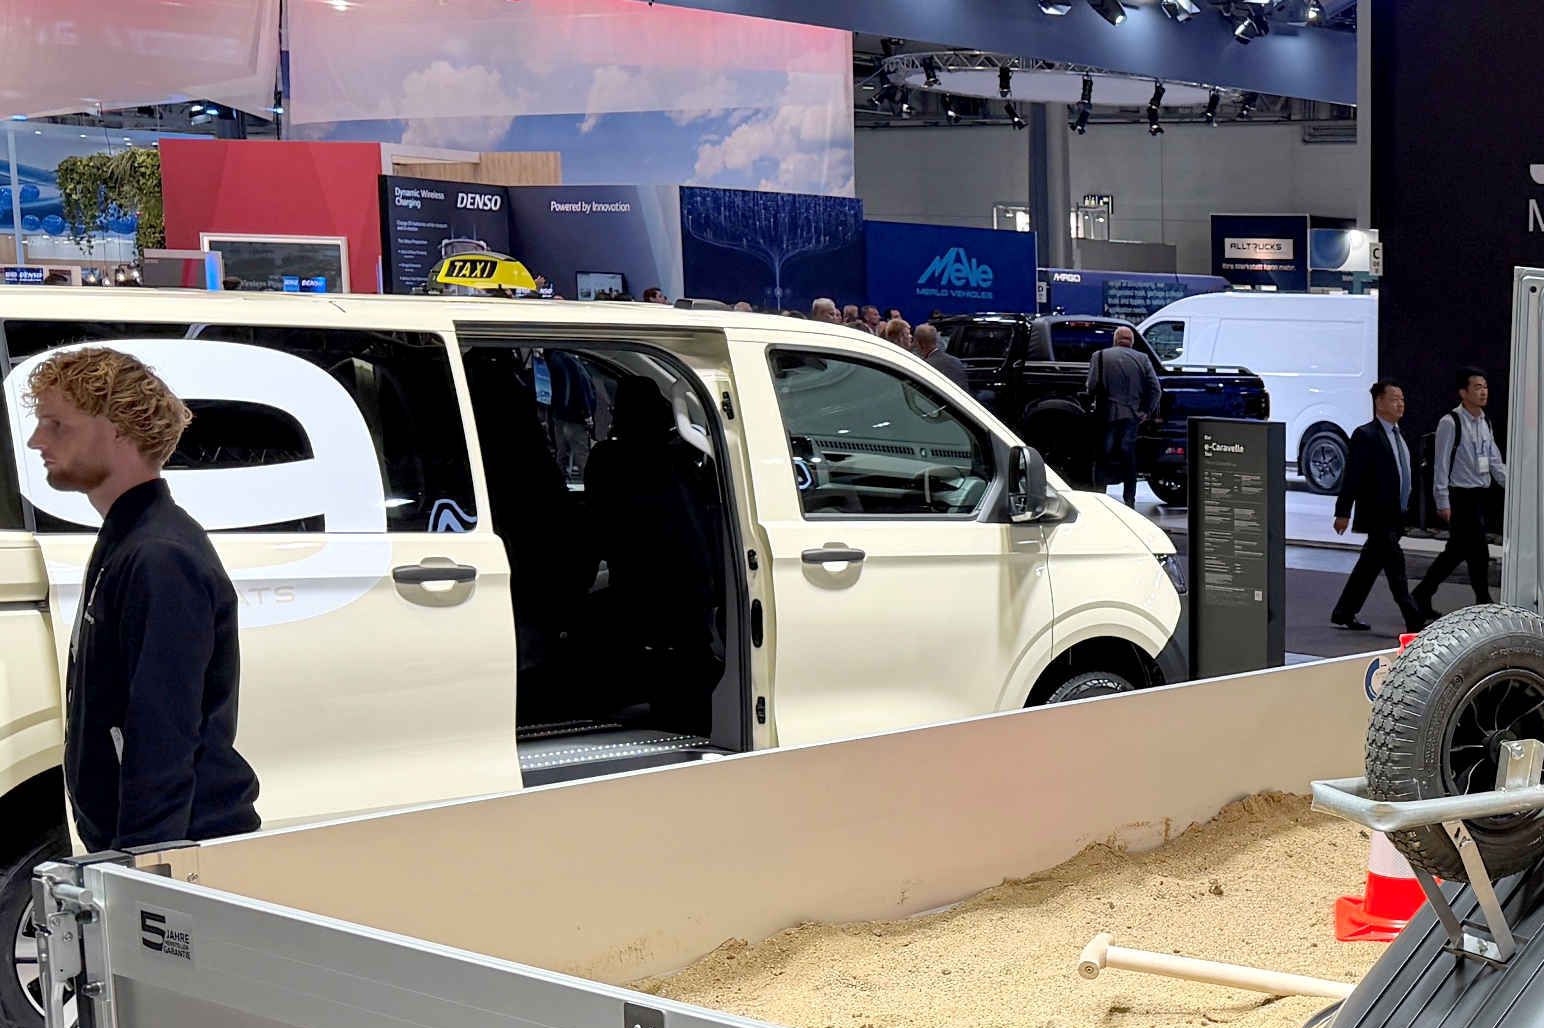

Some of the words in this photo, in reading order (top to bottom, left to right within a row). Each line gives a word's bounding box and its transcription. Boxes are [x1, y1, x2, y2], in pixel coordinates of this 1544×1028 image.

[395, 187, 420, 198] Dynamic
[421, 189, 445, 200] Wireless
[395, 197, 421, 209] Charging
[457, 193, 501, 211] DENSO
[551, 200, 581, 212] Powered
[582, 201, 592, 214] by
[592, 201, 631, 212] Innovation
[1230, 242, 1283, 251] ALLTRUCKS
[453, 261, 492, 278] TAXI
[140, 909, 166, 952] 5
[166, 929, 190, 944] JAHRE
